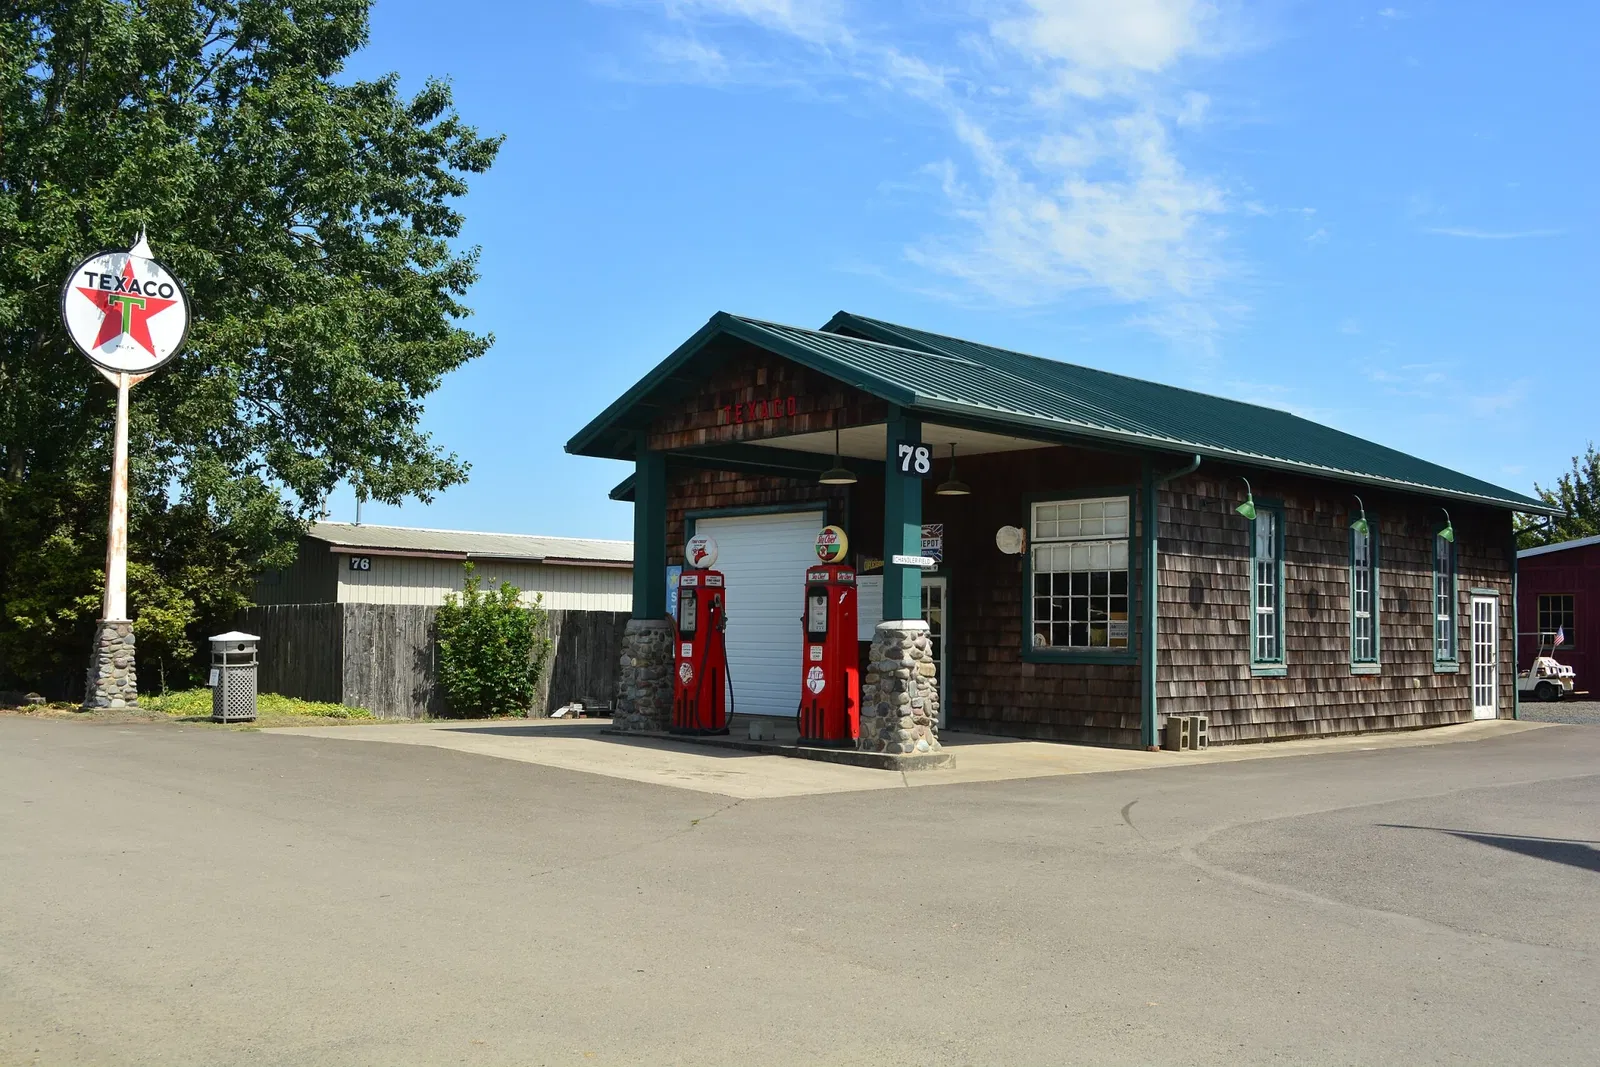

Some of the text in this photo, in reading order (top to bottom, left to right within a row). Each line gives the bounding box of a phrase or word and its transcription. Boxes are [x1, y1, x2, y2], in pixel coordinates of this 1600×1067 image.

[84, 271, 174, 299] TEXACO
[723, 395, 797, 425] TEXACO
[899, 444, 930, 474] 78
[351, 557, 370, 570] 76
[895, 556, 931, 565] CHANDLER FIELD
